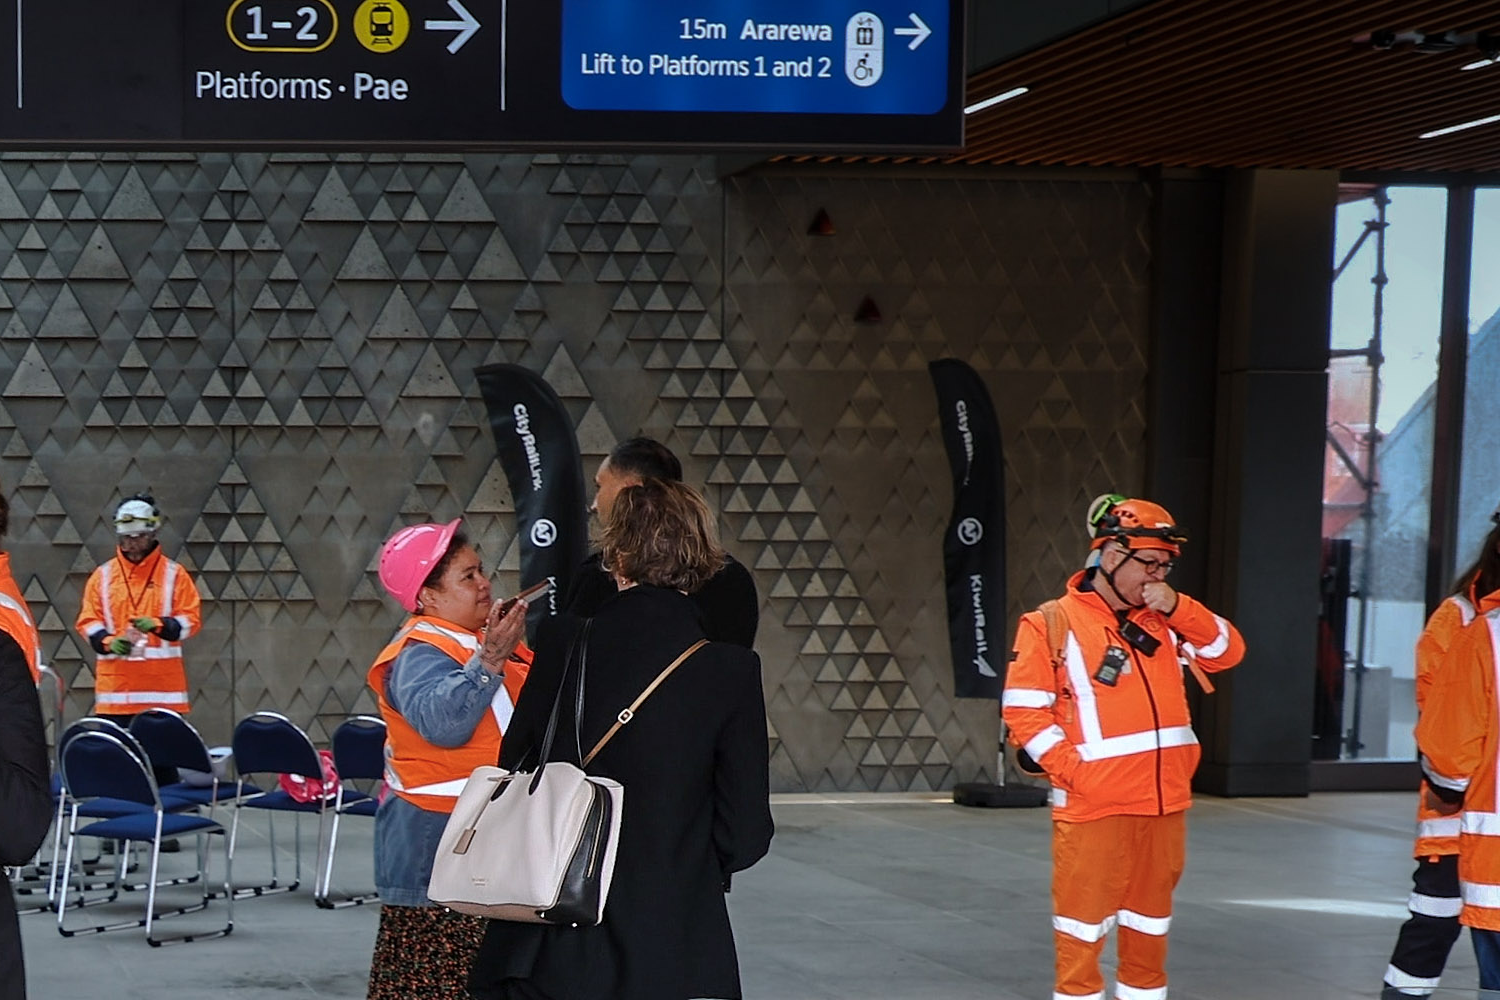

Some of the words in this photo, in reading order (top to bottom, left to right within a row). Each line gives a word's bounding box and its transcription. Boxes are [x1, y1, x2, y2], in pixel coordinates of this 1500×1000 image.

[246, 6, 318, 40] 1-2
[679, 18, 727, 39] 15m
[739, 19, 832, 41] Ararewa
[581, 52, 616, 75] Lift
[620, 55, 644, 75] to
[649, 54, 750, 77] Platforms
[754, 56, 768, 77] 1
[772, 56, 813, 78] and
[817, 57, 831, 78] 2
[196, 70, 332, 100] Platforms
[354, 72, 409, 100] Pae
[970, 574, 988, 654] KiwiRail
